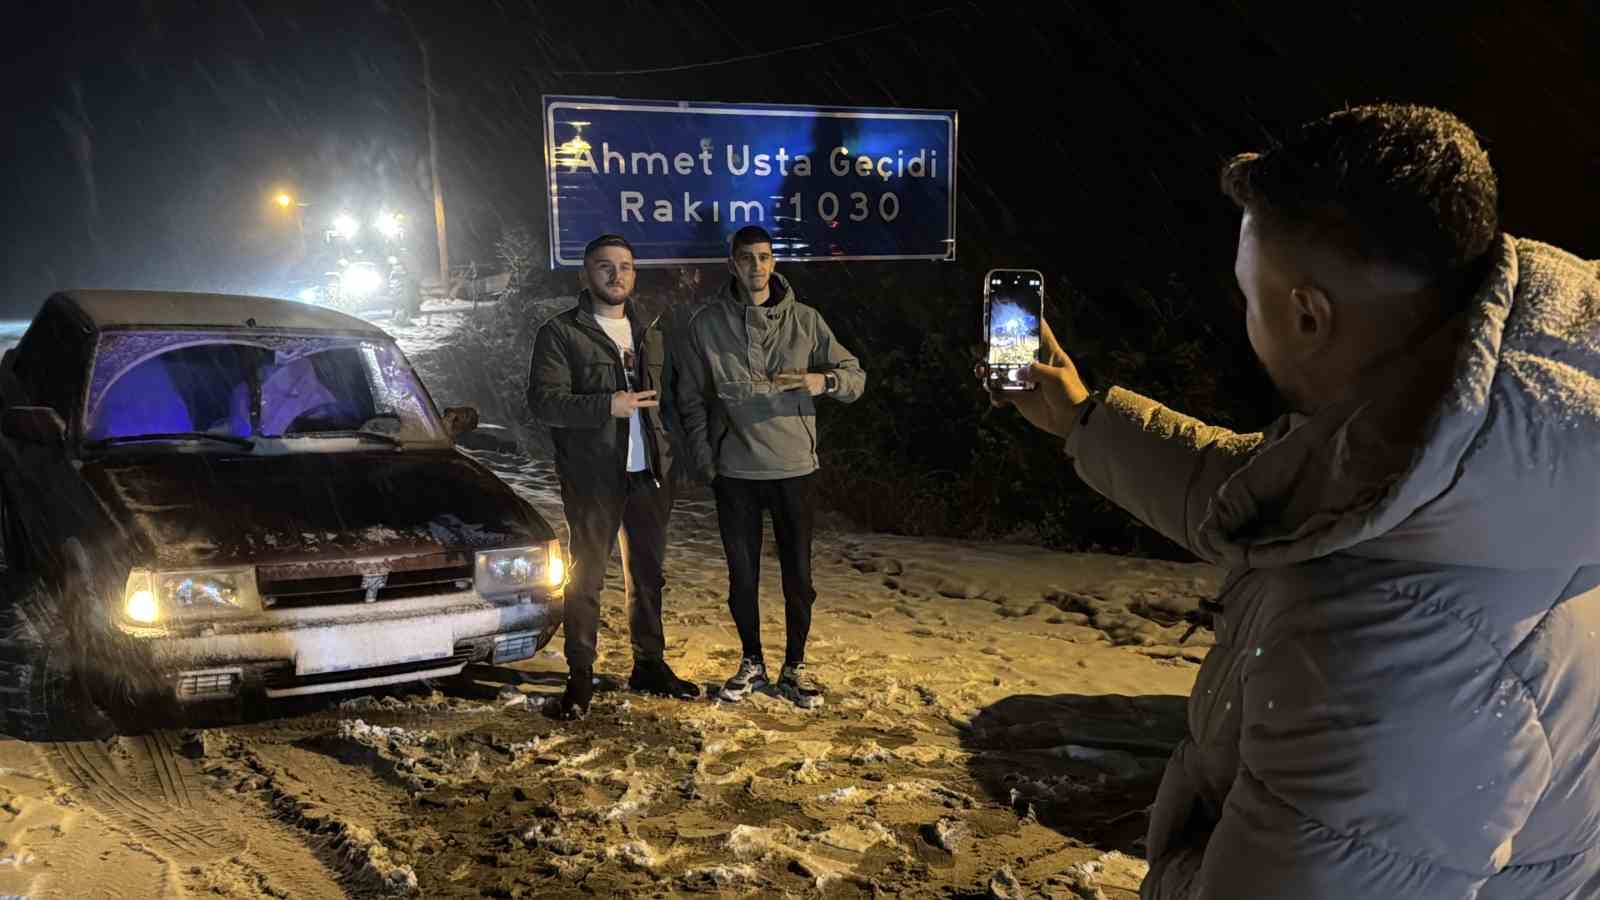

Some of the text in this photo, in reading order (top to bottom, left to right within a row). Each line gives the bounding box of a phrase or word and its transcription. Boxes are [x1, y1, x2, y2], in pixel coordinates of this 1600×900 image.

[569, 142, 937, 181] Ahmet Usta Geçidi
